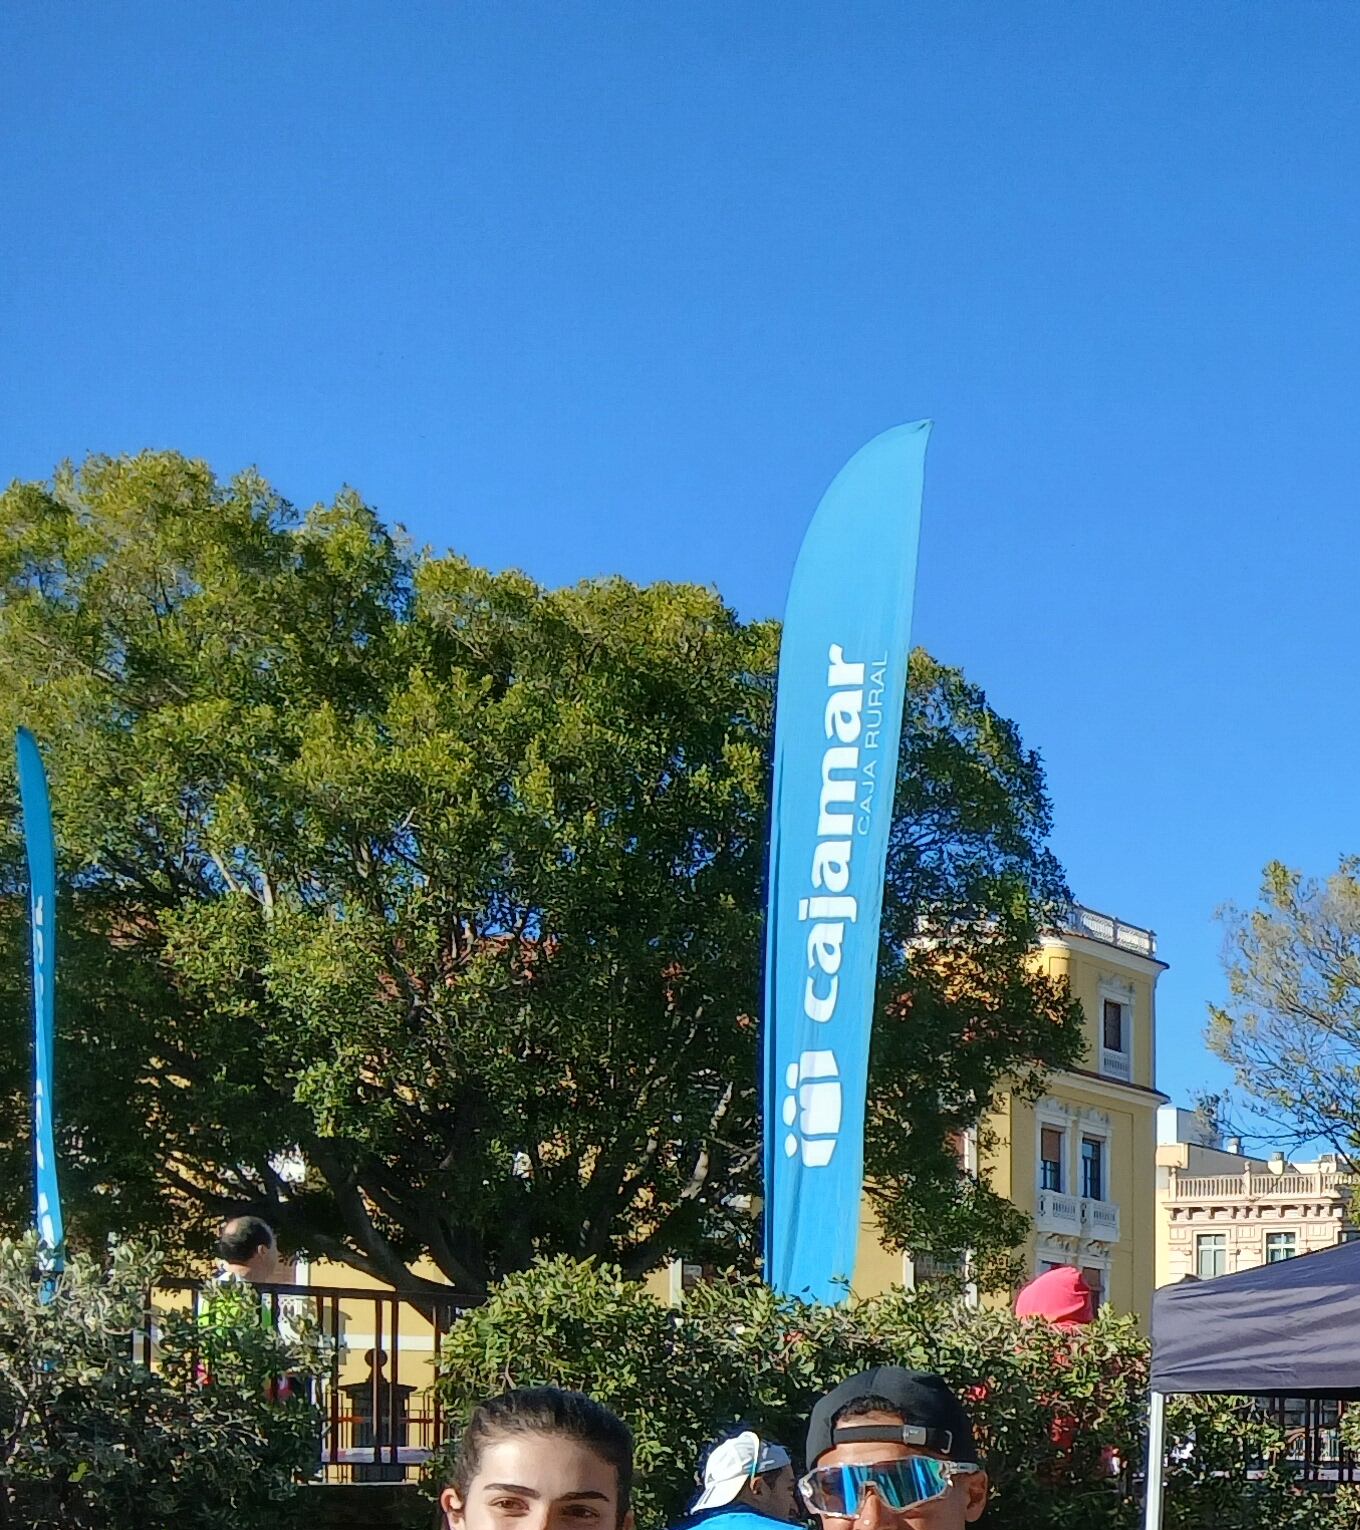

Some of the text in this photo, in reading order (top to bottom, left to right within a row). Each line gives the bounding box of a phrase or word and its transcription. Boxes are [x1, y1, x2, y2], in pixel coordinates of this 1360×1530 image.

[799, 643, 865, 1023] cajamar
[857, 650, 888, 837] CAJA RURAL
